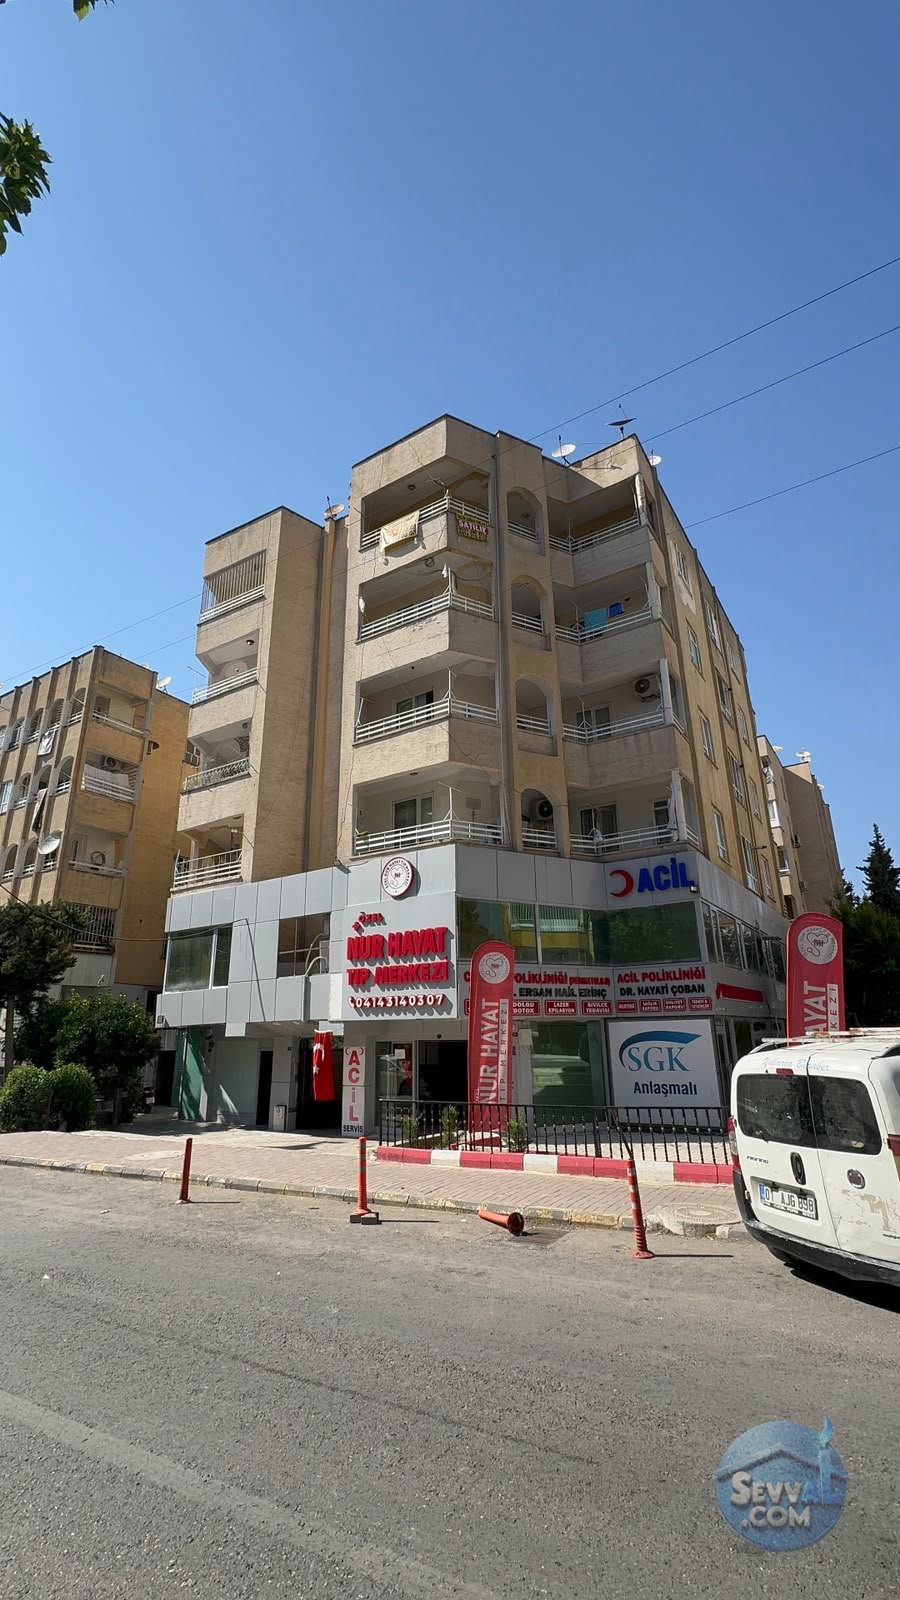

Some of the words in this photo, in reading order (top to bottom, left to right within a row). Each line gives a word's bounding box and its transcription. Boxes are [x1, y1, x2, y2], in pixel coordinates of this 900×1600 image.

[458, 520, 487, 534] SATILIK
[637, 857, 695, 893] ACİL
[358, 911, 384, 924] ÖZEL
[346, 934, 385, 961] NUR
[388, 926, 449, 958] HAYAT
[346, 967, 371, 986] TIP
[374, 955, 449, 985] MERKEZİ
[513, 971, 568, 985] OLİKLİNİĞİ
[617, 970, 640, 984] ACİL
[641, 966, 706, 983] POLİKLİNİĞİ
[619, 987, 636, 997] DR.
[638, 982, 669, 996] HAYATİ
[671, 983, 706, 998] ÇOBAN
[356, 994, 445, 1009] 04143140307
[803, 981, 827, 1037] AYAT
[480, 997, 499, 1058] HAYAT
[627, 1046, 691, 1072] SGK
[479, 1064, 498, 1104] NUR
[499, 1078, 507, 1102] TIP
[633, 1080, 698, 1098] Anlaşmalı
[343, 1123, 364, 1133] SERVİS
